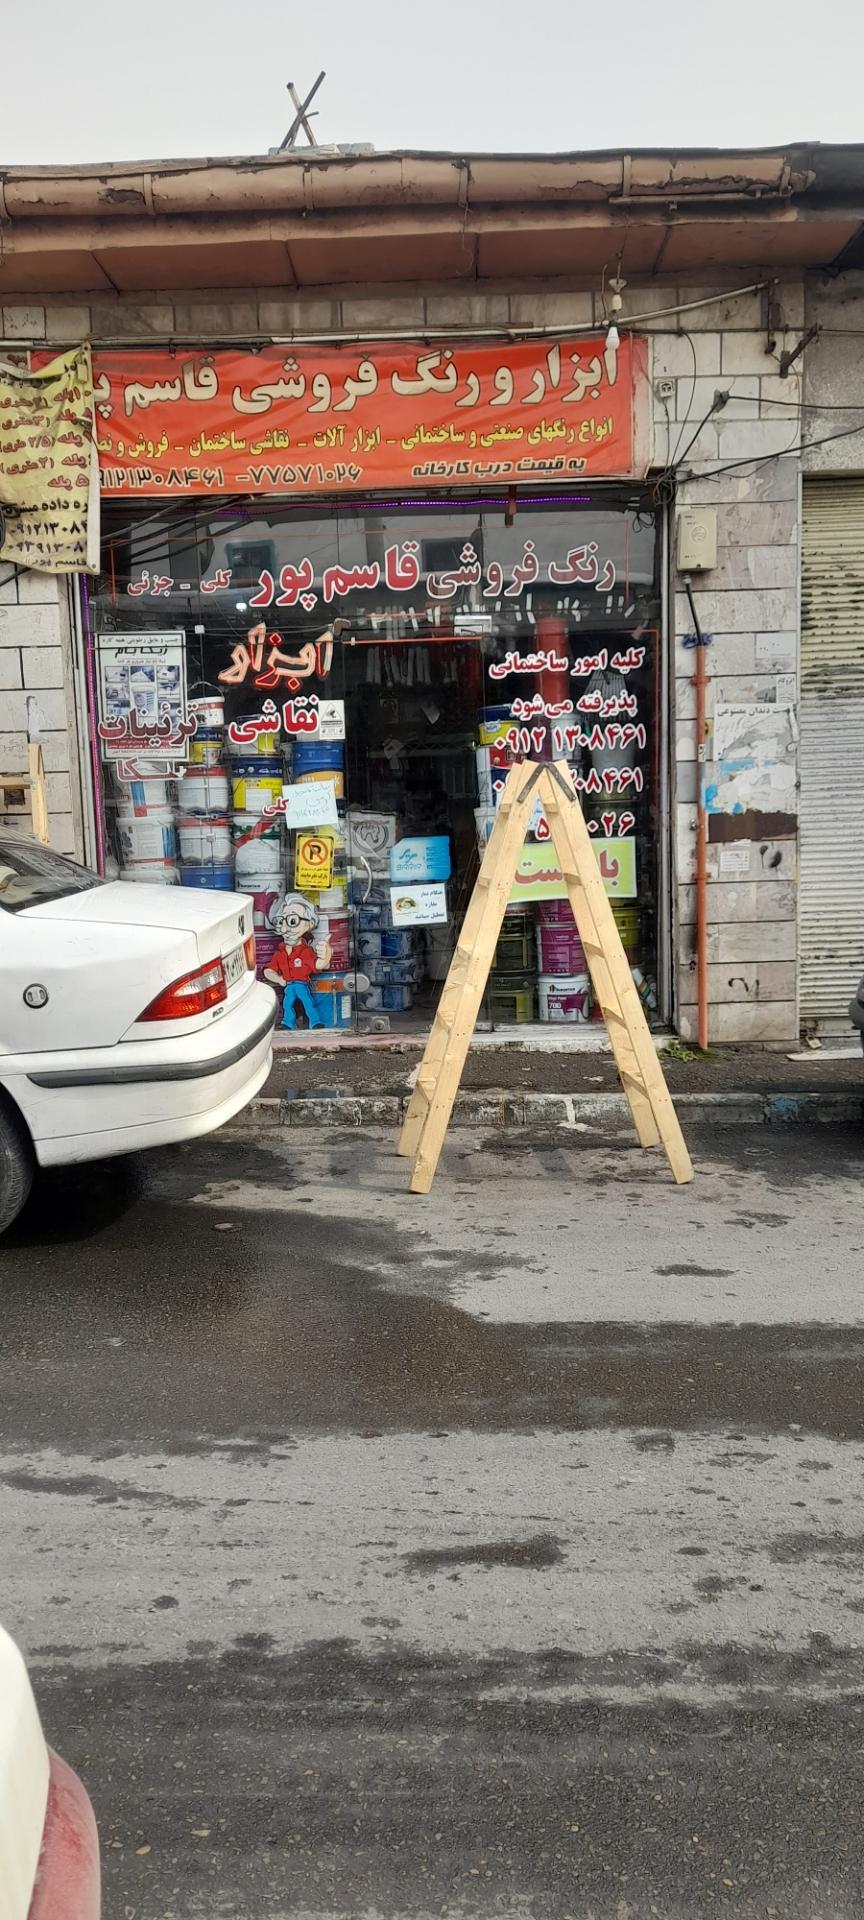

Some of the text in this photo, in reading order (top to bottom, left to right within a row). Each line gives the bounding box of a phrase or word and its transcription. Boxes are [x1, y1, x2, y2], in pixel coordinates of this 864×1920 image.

[124, 355, 219, 417] قاسم
[232, 353, 378, 415] فروشی
[391, 349, 480, 407] رنگ
[488, 366, 514, 406] و
[521, 344, 618, 403] ابزار
[250, 428, 289, 455] نقاشی
[313, 424, 345, 448] آلات
[351, 425, 381, 452] ابزار
[401, 423, 464, 450] ساختمانی
[469, 430, 476, 447] و
[480, 423, 524, 447] صنعتی
[527, 418, 574, 445] رنگهای
[578, 415, 613, 444] انواع
[117, 441, 125, 457] و
[128, 430, 168, 458] فروش
[189, 431, 246, 457] ساختمان
[100, 466, 224, 488] ۹۱۲۱۳۰۸۴۶۱
[411, 456, 585, 478] به قیمت درب کارخانه
[42, 498, 69, 511] داده
[323, 540, 420, 603] قاسم
[426, 540, 539, 598] فروشی
[548, 541, 615, 591] رنگ
[128, 570, 174, 597] جزئی
[201, 569, 231, 593] کلی
[250, 558, 318, 611] پور
[218, 621, 335, 692] ابزار
[489, 646, 645, 679] کلیه امور ساختمانی
[577, 690, 637, 717] پذیرفته
[98, 702, 198, 746] تزئینات
[228, 694, 320, 744] نقاشی
[494, 723, 646, 753] ۰۹۱۲ ۱۳۰۸۴۶۱
[571, 766, 643, 794] ۰۸۴۶۱
[262, 796, 289, 817] کلی
